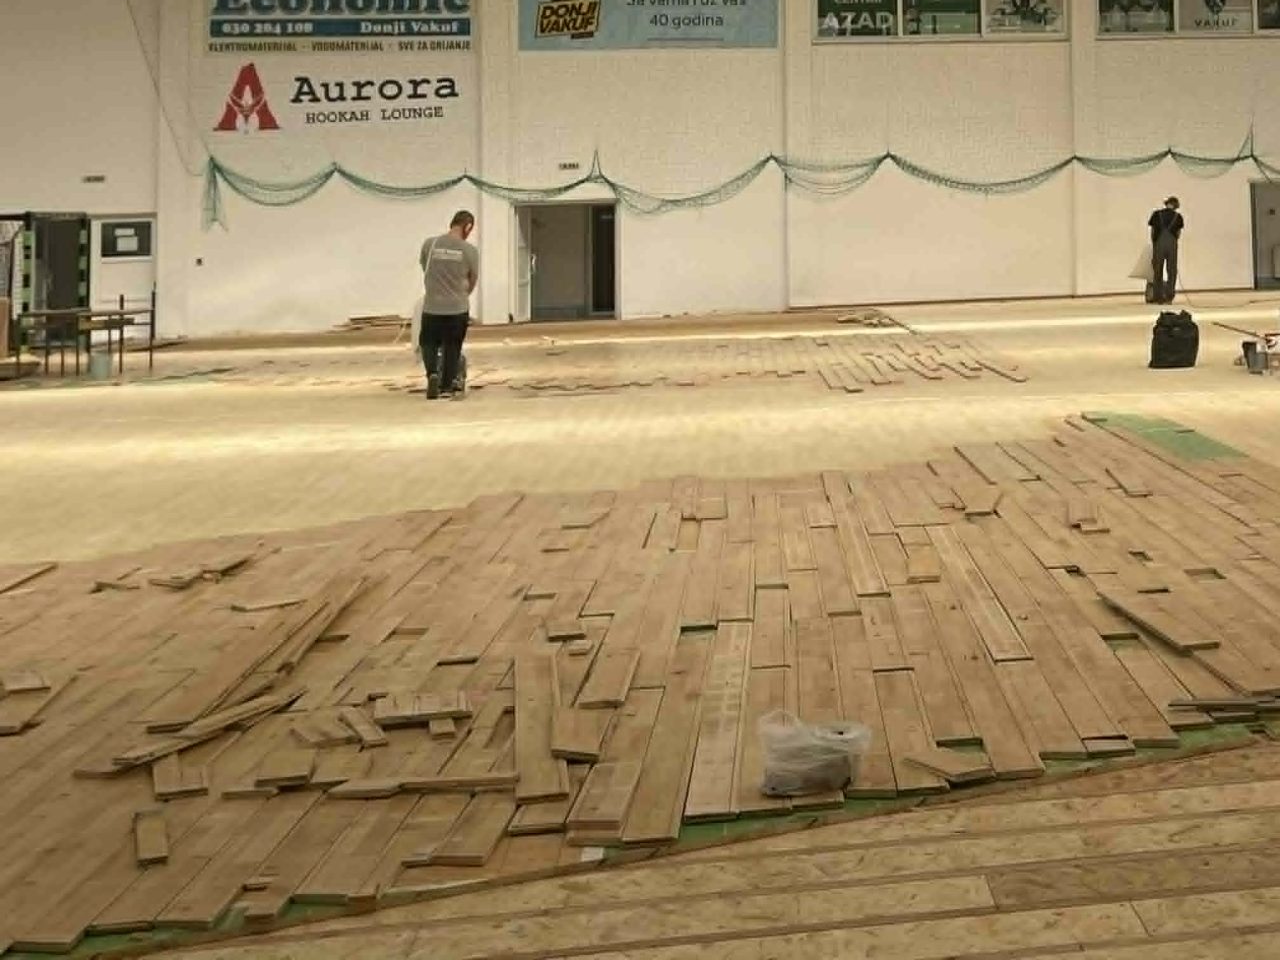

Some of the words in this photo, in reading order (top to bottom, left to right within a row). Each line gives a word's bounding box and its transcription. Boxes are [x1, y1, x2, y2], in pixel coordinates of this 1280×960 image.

[541, 1, 598, 20] DONJI
[361, 21, 406, 35] Donji
[411, 21, 459, 33] Vakuf
[540, 16, 596, 33] VAKUF
[649, 14, 669, 26] 40
[671, 14, 724, 30] godina
[398, 41, 414, 51] SVE
[290, 76, 459, 103] Aurora
[305, 110, 370, 124] HOOKAH
[381, 106, 444, 121] LOUNGE
